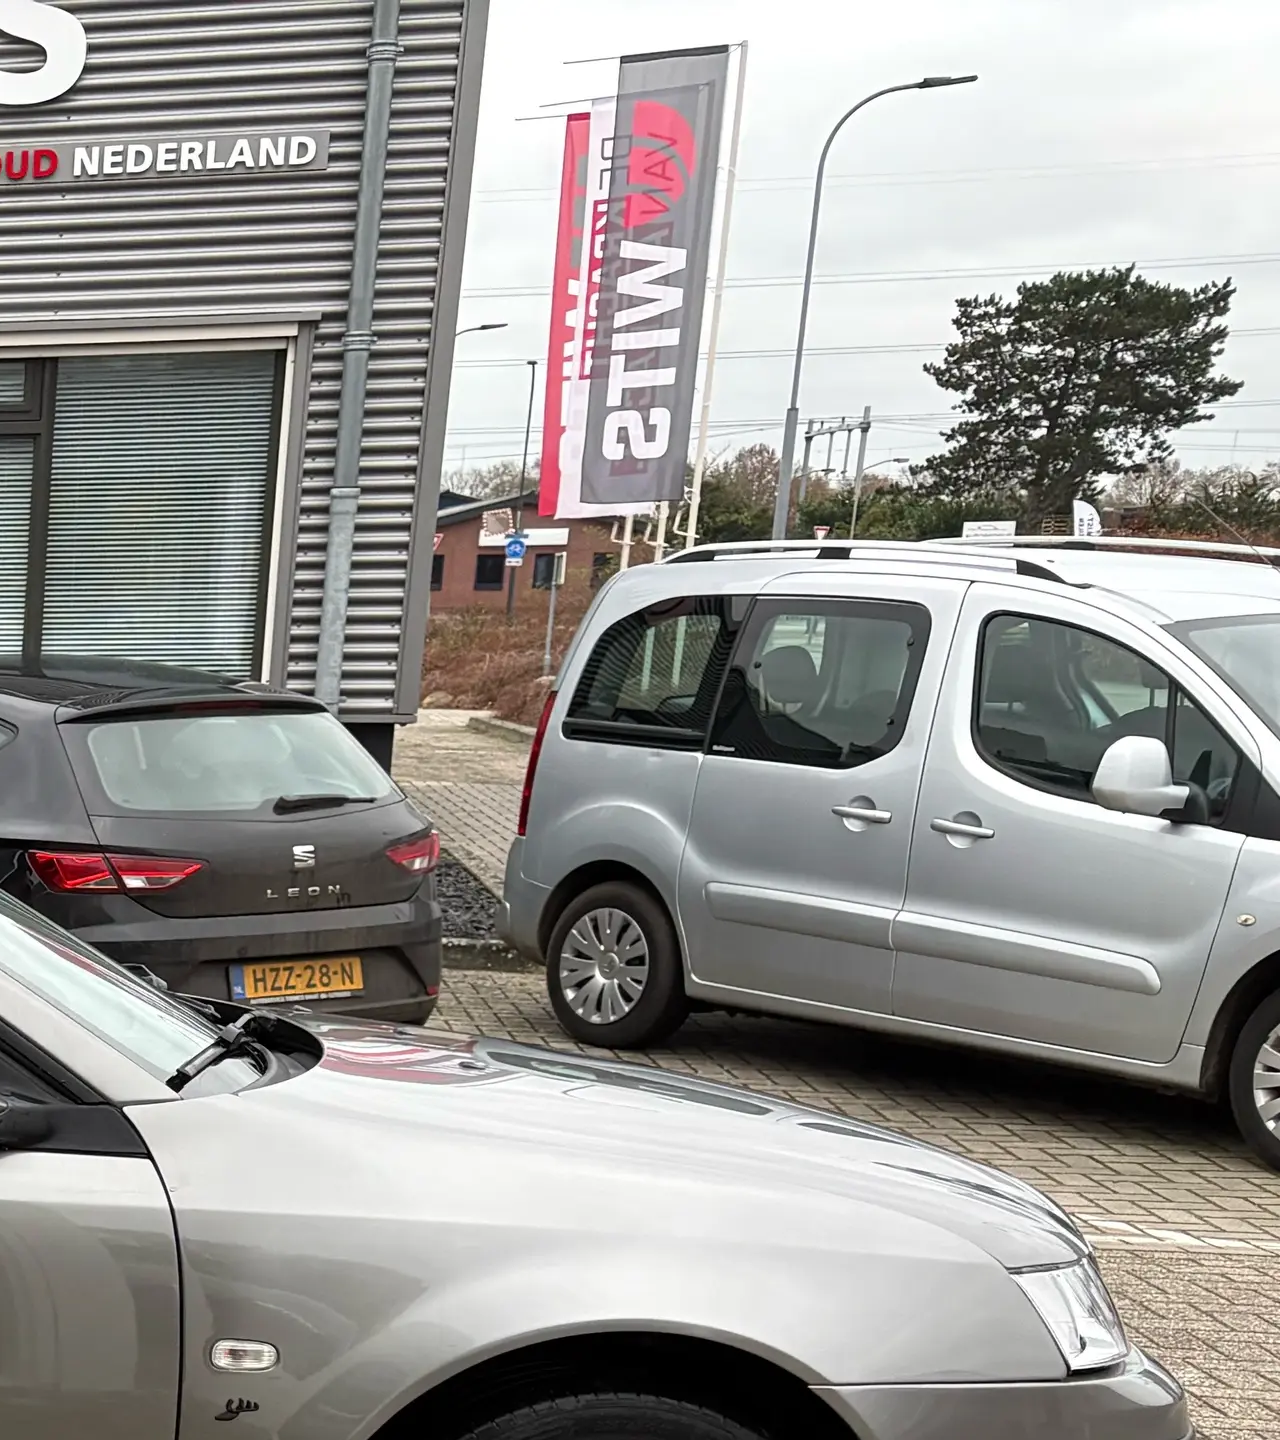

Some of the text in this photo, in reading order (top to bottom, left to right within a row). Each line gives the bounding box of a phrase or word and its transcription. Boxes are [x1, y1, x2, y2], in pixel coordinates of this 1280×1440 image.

[73, 135, 318, 177] NEDERLAND
[266, 884, 341, 898] LEON
[251, 961, 355, 993] HZZ-28-N
